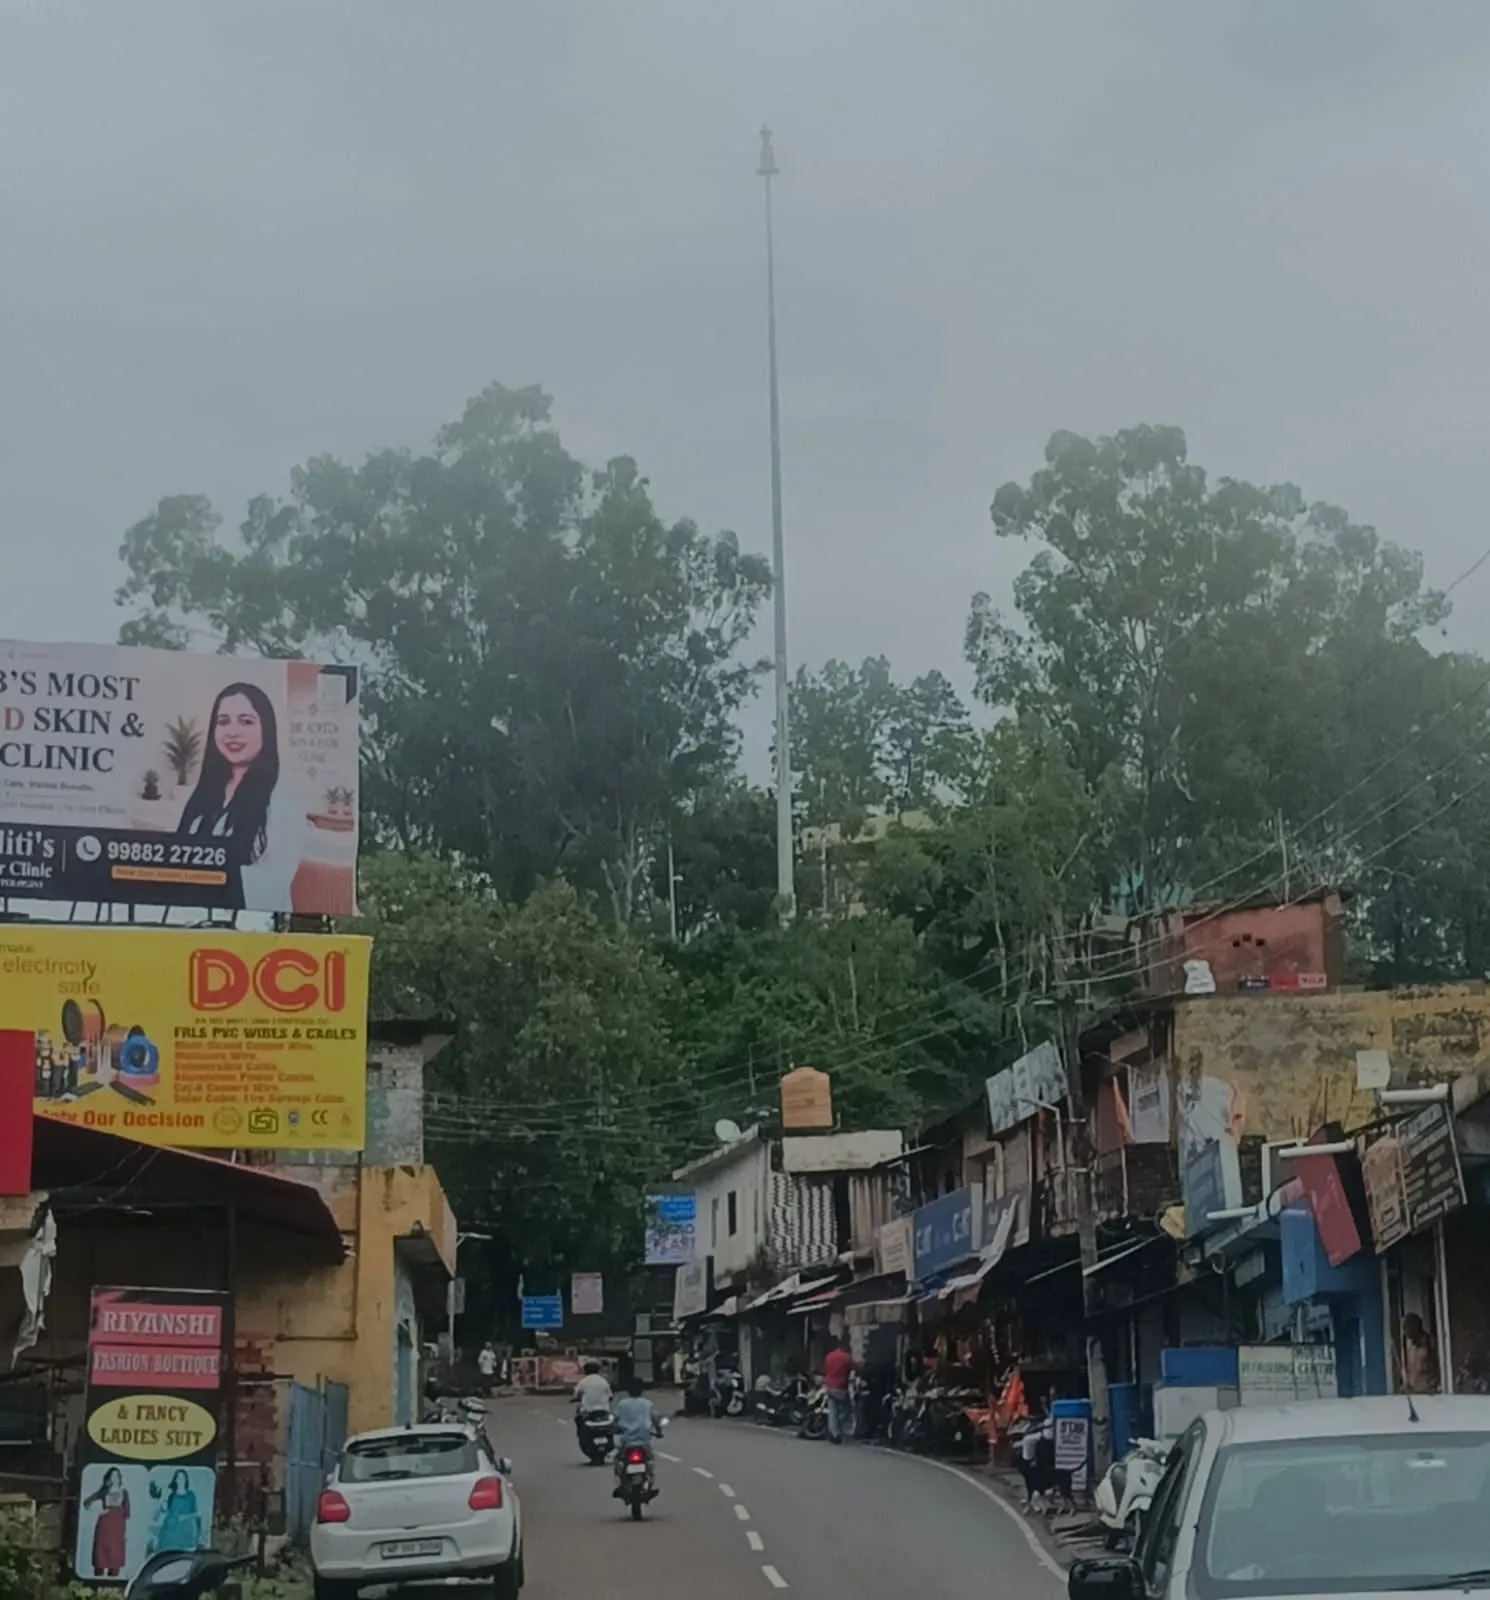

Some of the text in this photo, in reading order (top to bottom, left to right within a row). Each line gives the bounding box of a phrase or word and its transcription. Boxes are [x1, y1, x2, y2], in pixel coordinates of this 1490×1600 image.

[47, 671, 141, 701] MOST
[4, 706, 145, 738] D SKIN &
[0, 742, 115, 773] CLINIC
[107, 841, 164, 863] 99882
[169, 845, 227, 866] 27226
[9, 861, 53, 879] Clinic
[3, 956, 97, 980] electricity
[57, 975, 100, 995] safe
[189, 948, 346, 1013] DCI
[212, 1027, 239, 1040] PVC
[243, 1027, 288, 1040] WIRES
[291, 1028, 302, 1040] &
[305, 1028, 358, 1041] CABLES
[83, 1109, 116, 1126] Our
[122, 1111, 205, 1128] Decision
[102, 1311, 217, 1336] RIYANSHI
[153, 1354, 219, 1375] BOUTIQUE
[117, 1404, 189, 1422] & FANCY
[100, 1428, 203, 1447] LADIES SUIT
